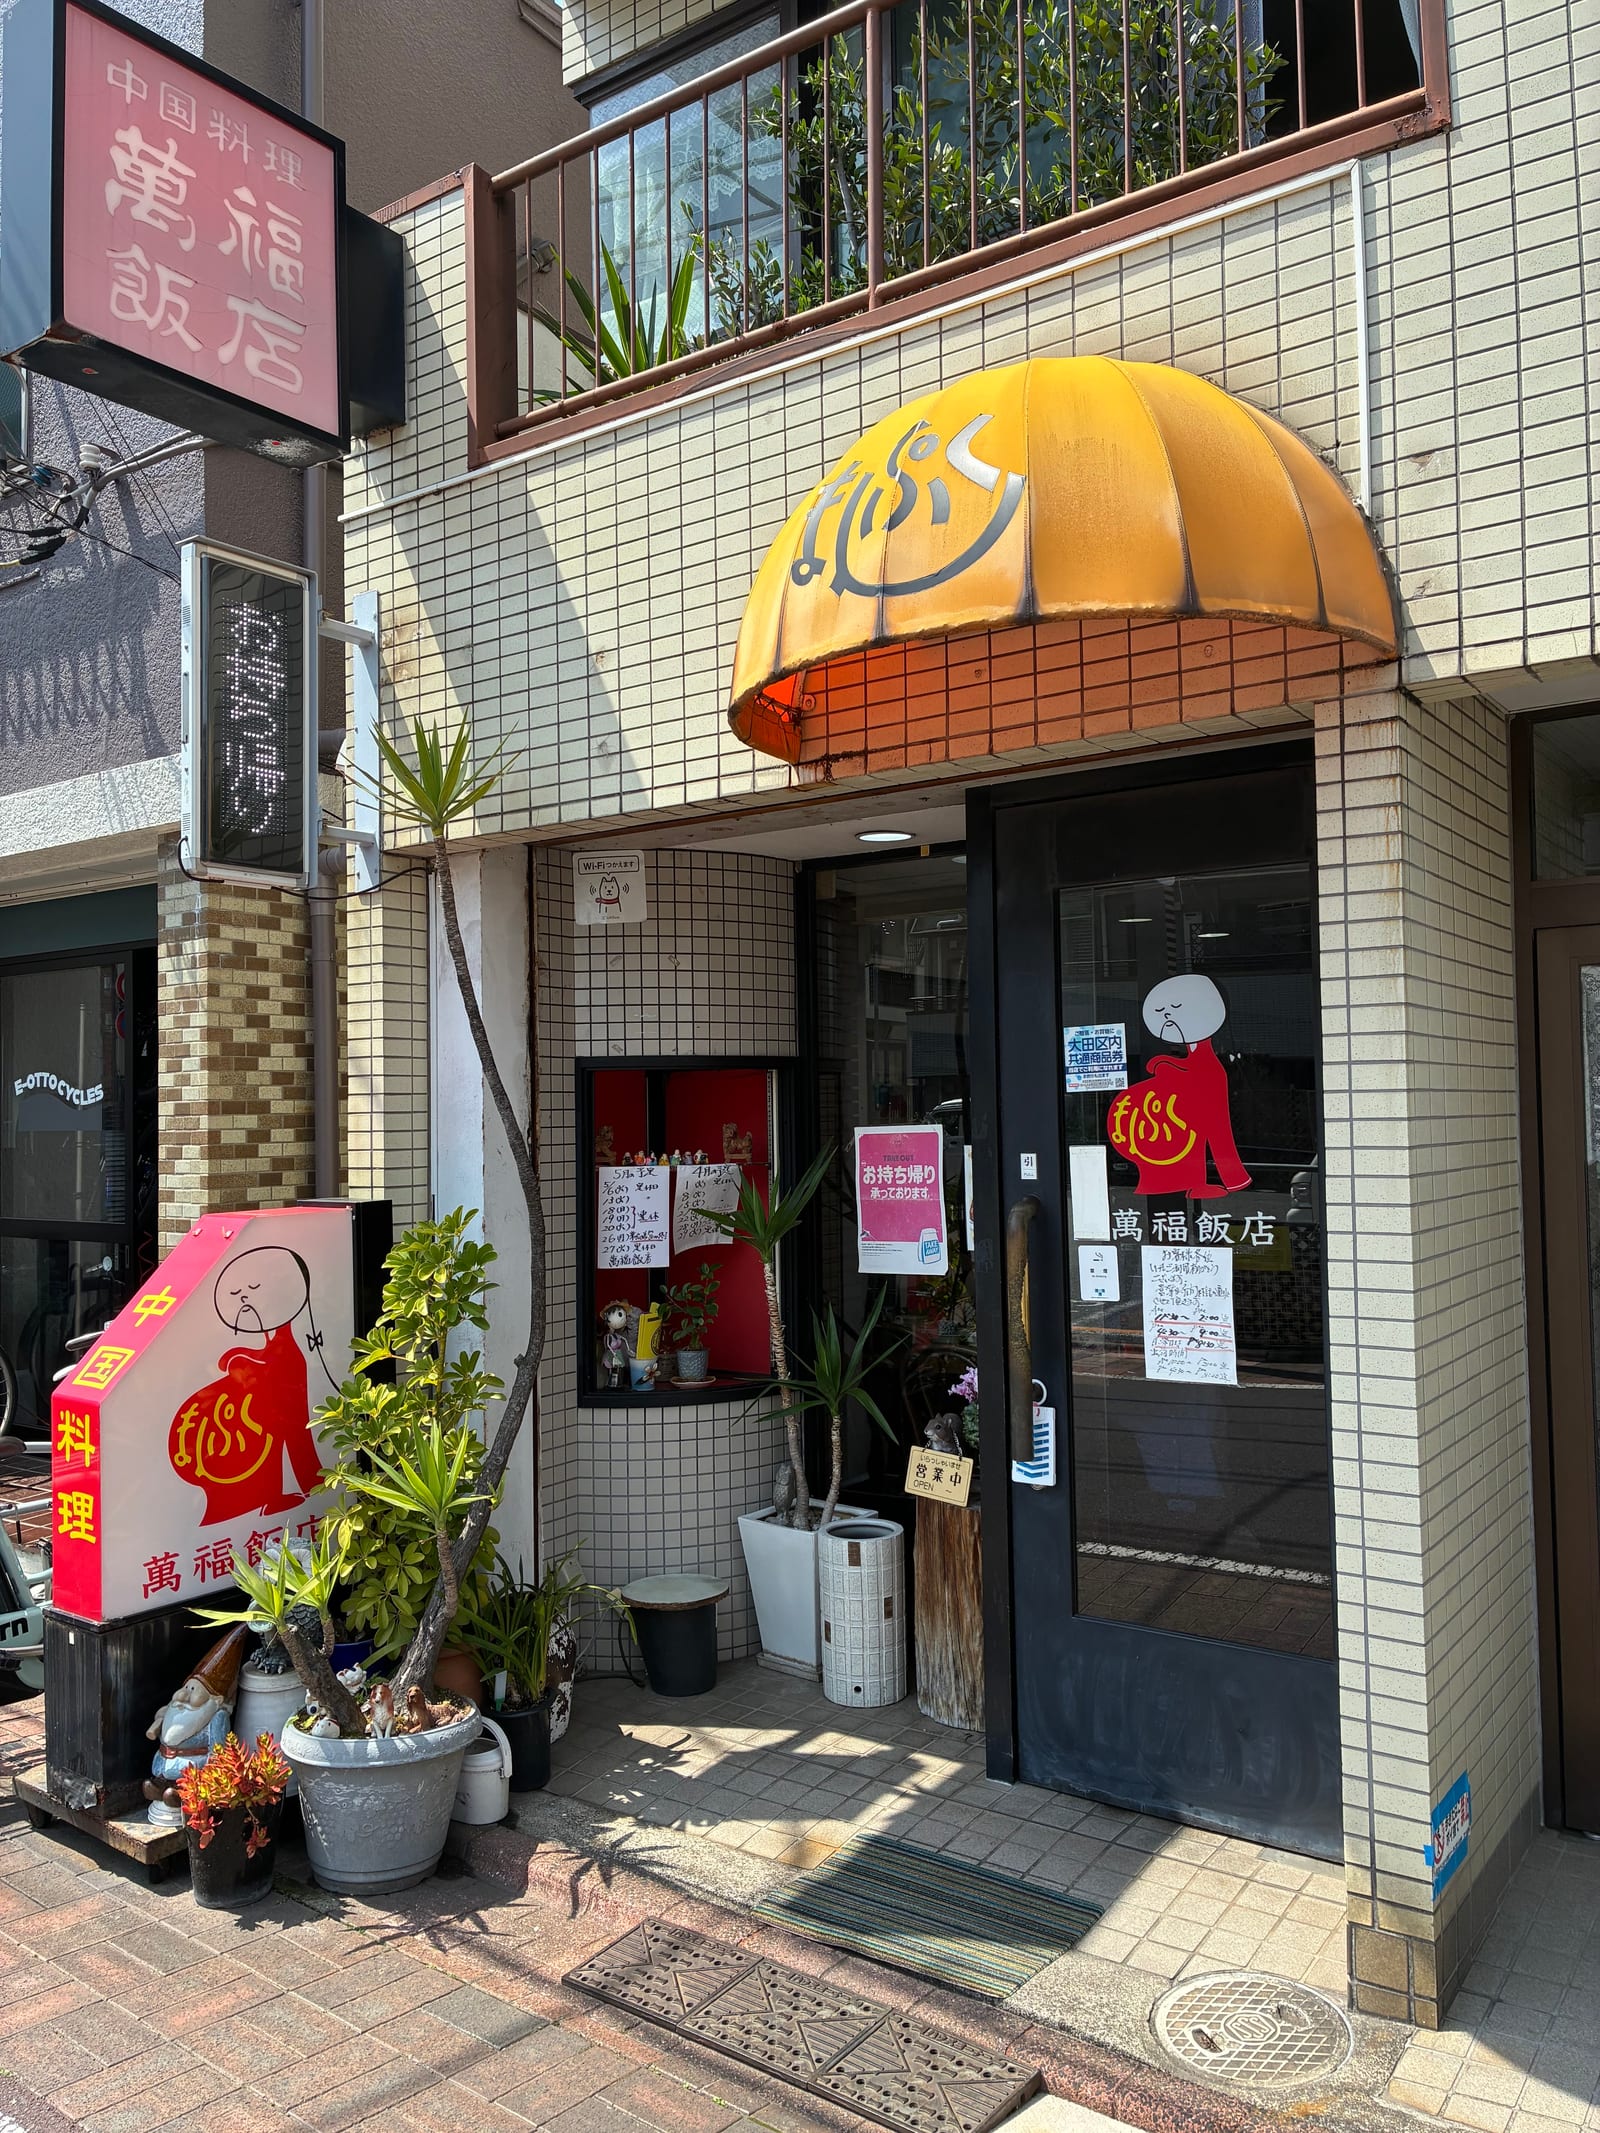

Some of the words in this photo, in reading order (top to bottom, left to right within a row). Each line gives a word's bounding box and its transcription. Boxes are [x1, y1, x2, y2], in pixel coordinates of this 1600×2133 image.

[106, 58, 305, 191] 中国料理
[104, 124, 305, 303] 萬福
[105, 243, 307, 395] 飯店
[225, 602, 286, 833] お持ち帰り
[1067, 1035, 1122, 1052] 大田区内
[1068, 1050, 1123, 1065] 共通商品券
[14, 1071, 58, 1096] E-OTTO
[57, 1080, 104, 1105] CYCLES
[1024, 1156, 1033, 1167] 引
[862, 1165, 936, 1185] お持ち帰り
[1111, 1208, 1278, 1247] 萬福飯店
[920, 1454, 962, 1470] いらっしゃいませ
[913, 1479, 935, 1492] OPEN
[916, 1463, 963, 1487] 営業中
